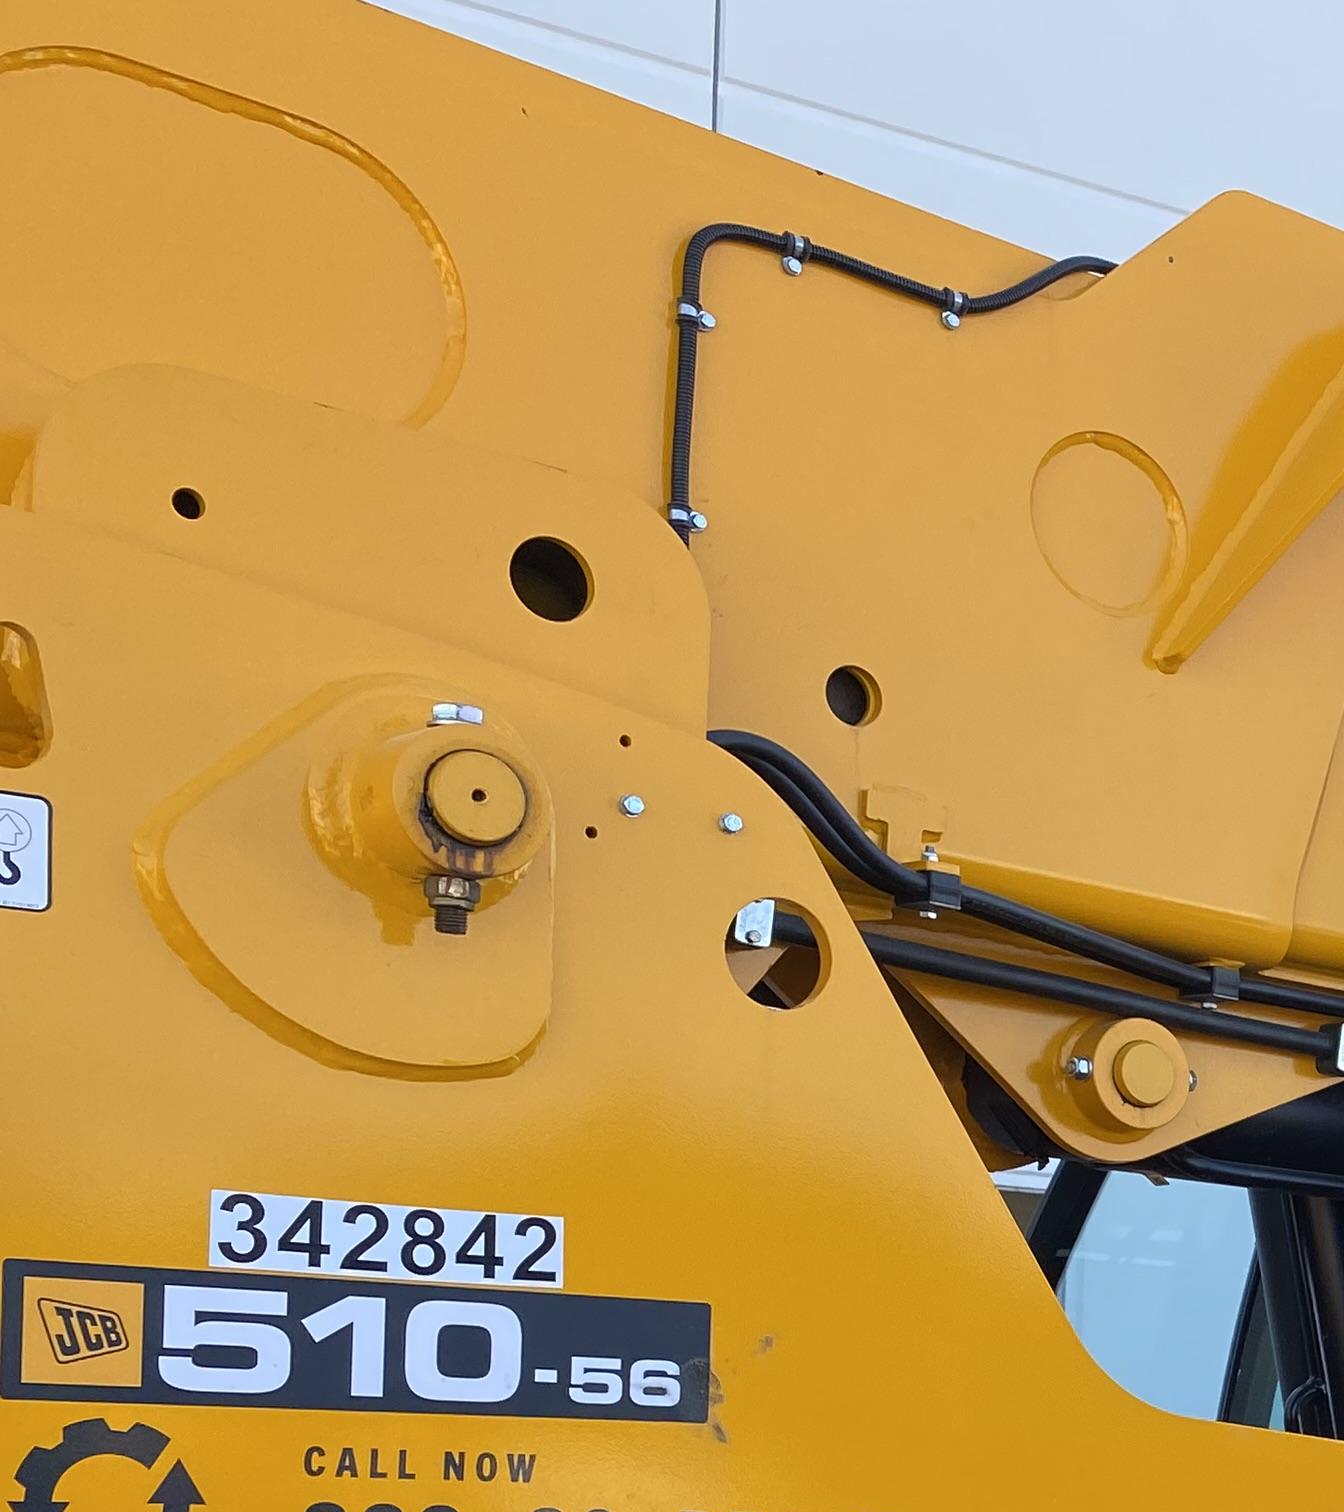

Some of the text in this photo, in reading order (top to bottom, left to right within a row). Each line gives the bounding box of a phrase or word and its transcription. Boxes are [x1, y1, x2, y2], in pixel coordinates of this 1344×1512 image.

[217, 1193, 559, 1284] 342842
[54, 1306, 122, 1356] JCB
[304, 1445, 537, 1482] CALL NOW
